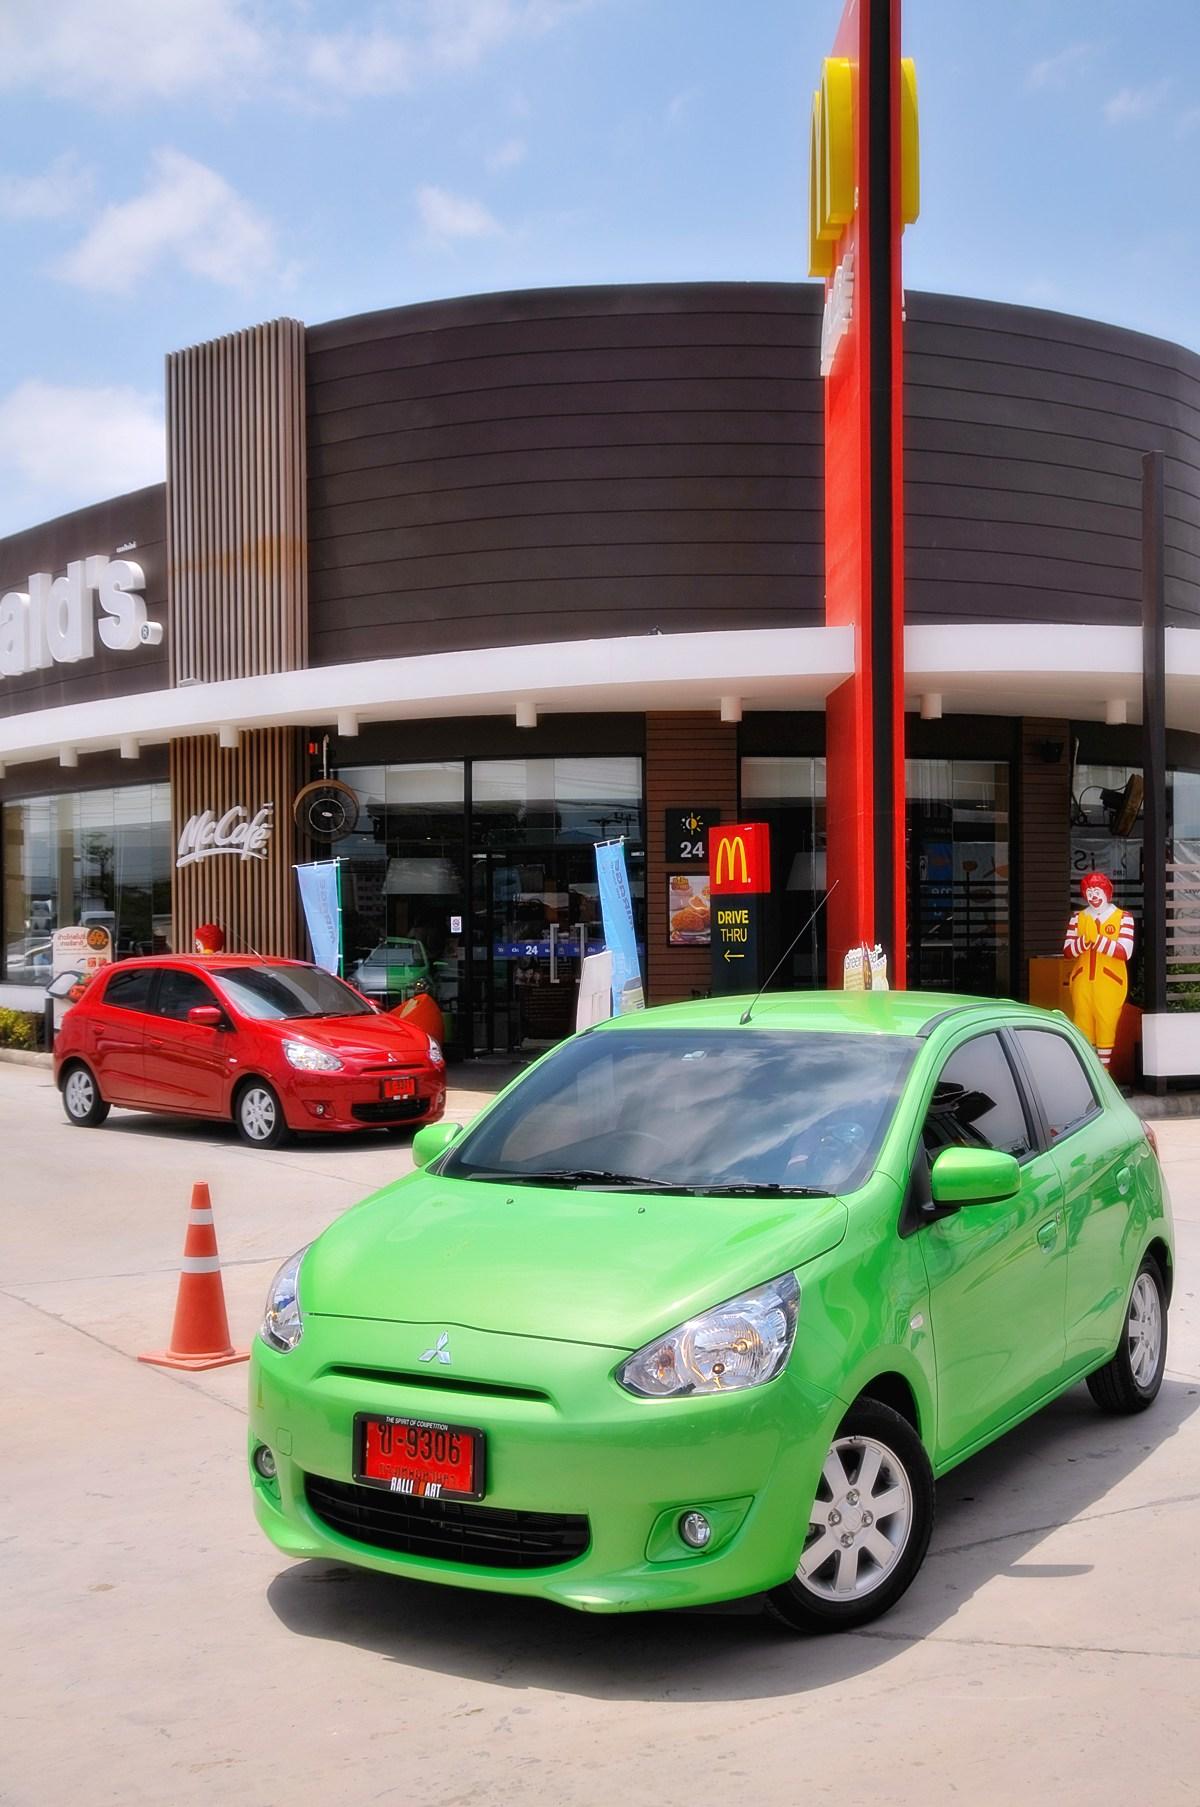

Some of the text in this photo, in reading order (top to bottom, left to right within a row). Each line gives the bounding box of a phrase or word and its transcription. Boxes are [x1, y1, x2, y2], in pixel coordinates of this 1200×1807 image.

[0, 554, 147, 678] ald's
[177, 802, 273, 864] McCafé
[680, 841, 705, 858] 24
[717, 910, 749, 925] DRIVE
[720, 928, 748, 942] THRU
[525, 945, 539, 955] 24
[386, 1416, 395, 1424] THE
[395, 1417, 410, 1425] SPIRIT
